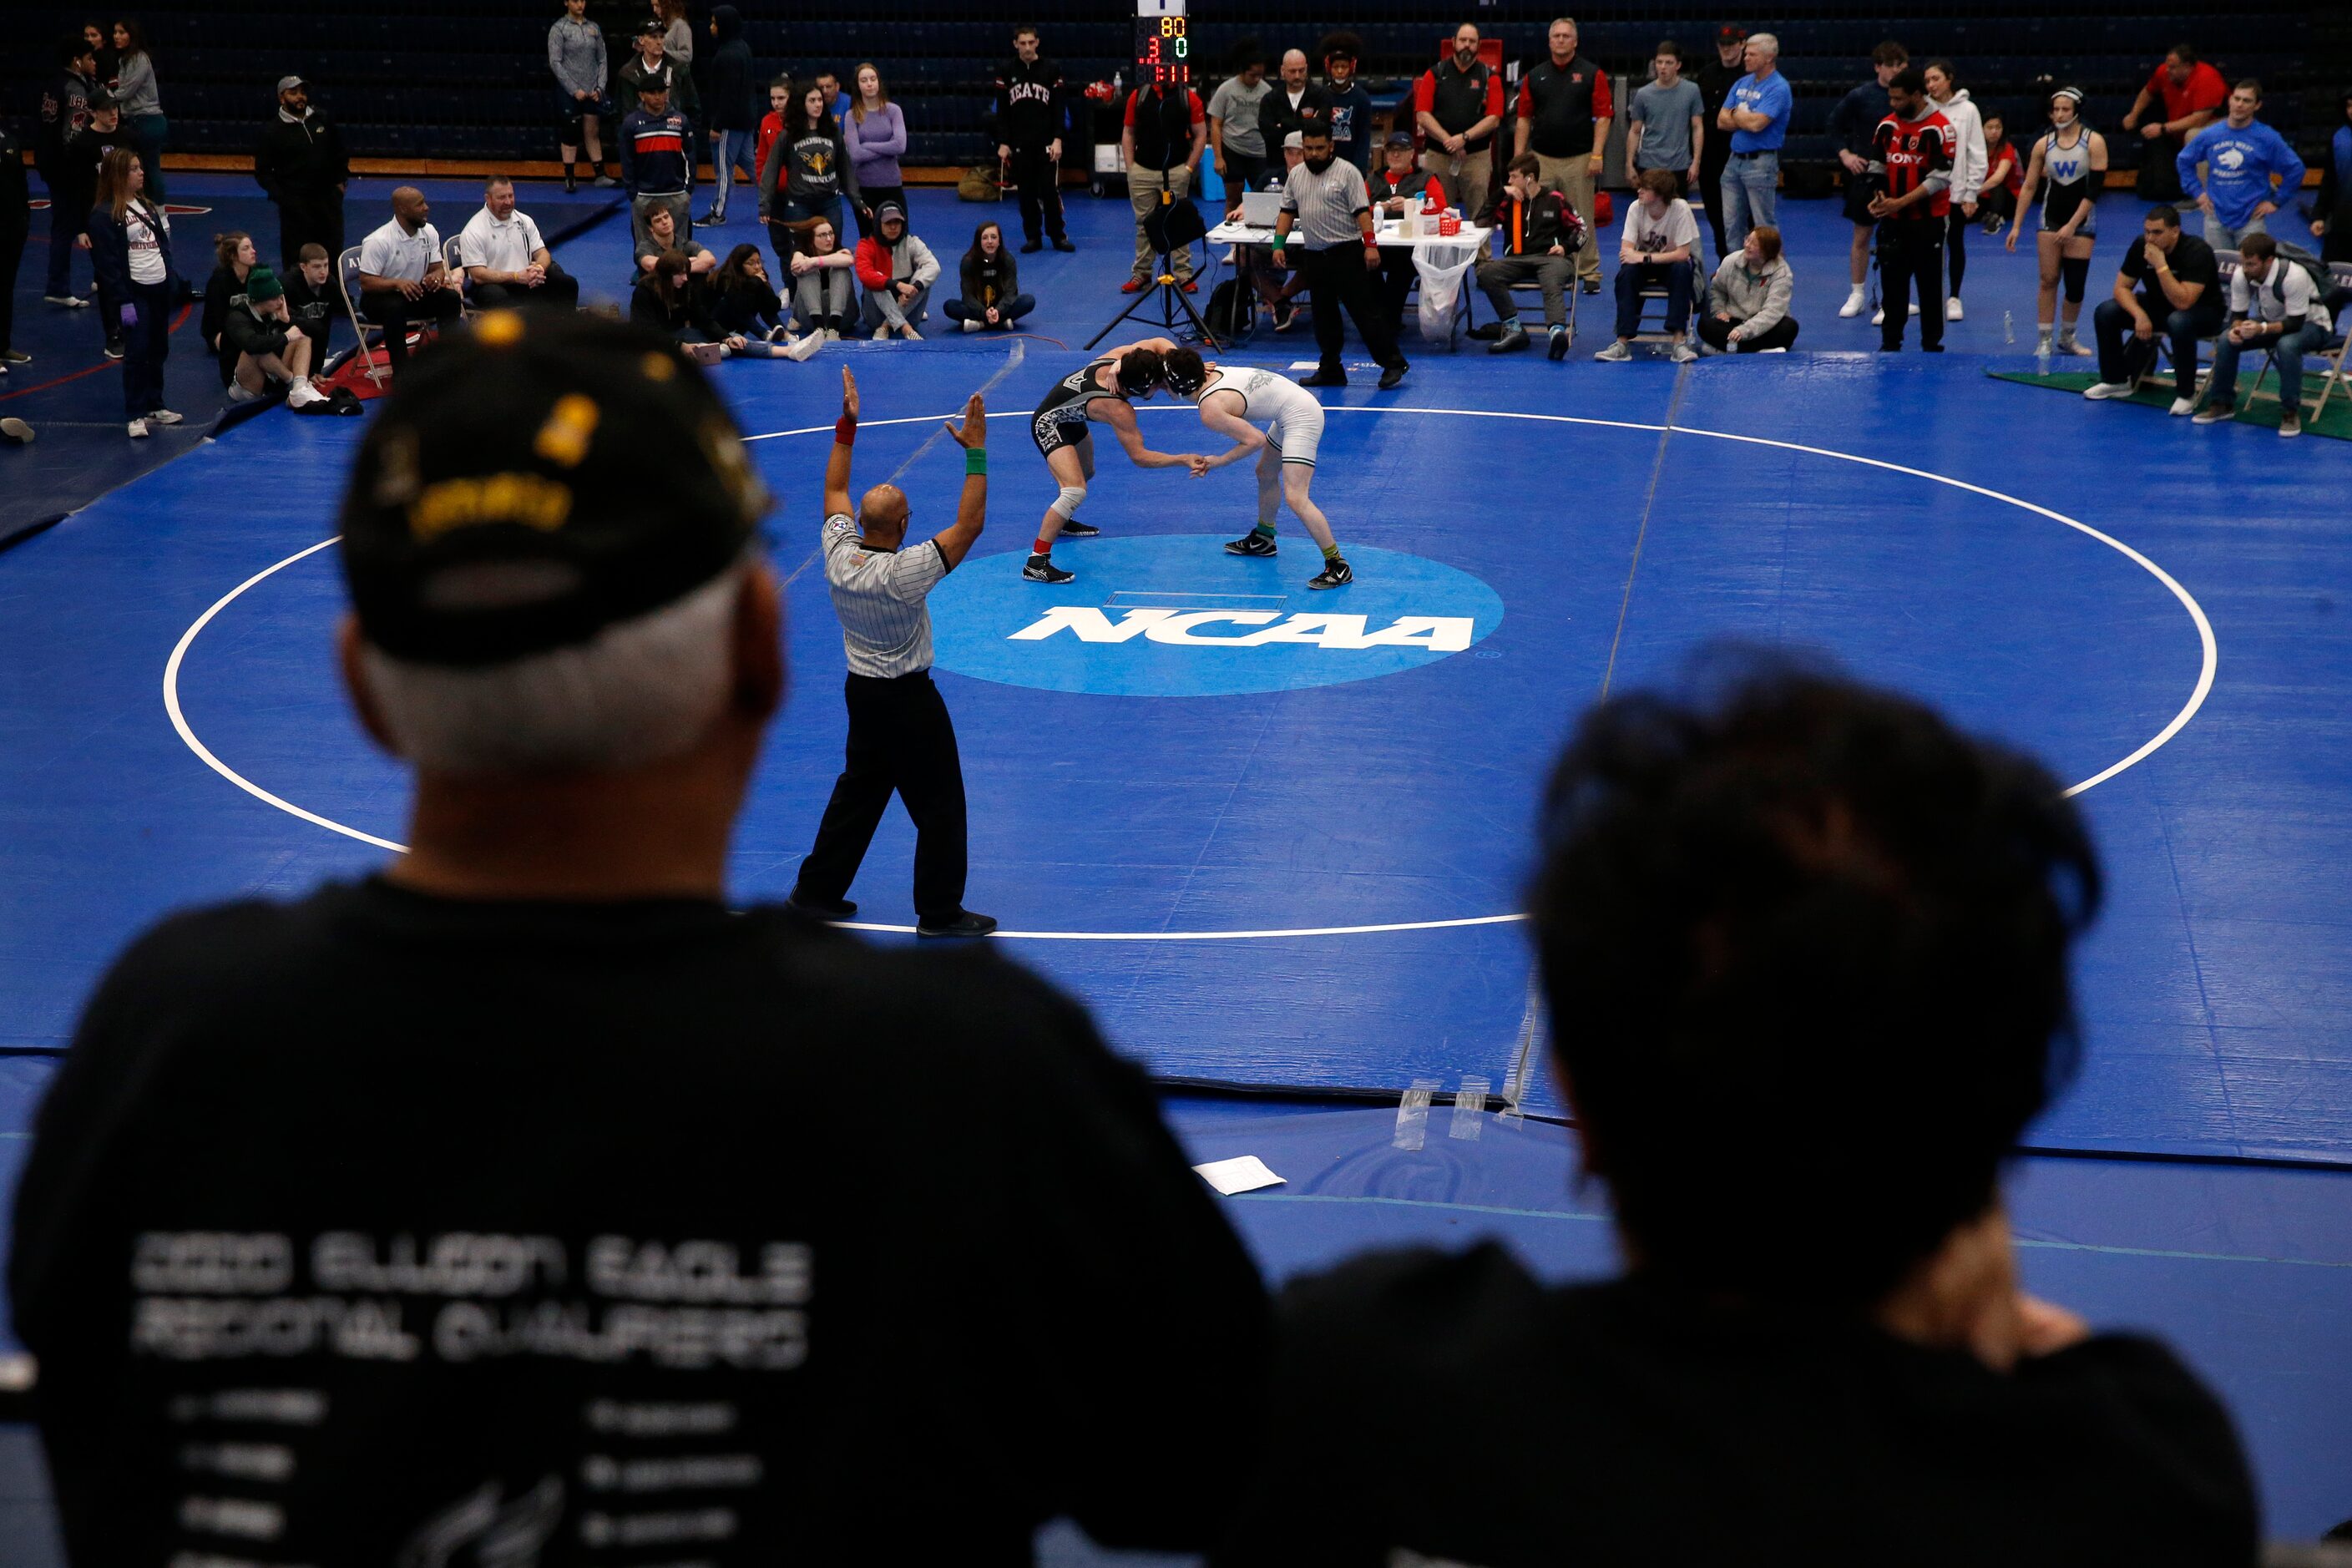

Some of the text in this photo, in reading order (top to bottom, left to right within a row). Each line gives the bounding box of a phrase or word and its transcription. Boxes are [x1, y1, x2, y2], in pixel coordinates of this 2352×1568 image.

[1161, 17, 1186, 38] 80
[1149, 37, 1187, 58] 3 0
[2053, 161, 2078, 178] W
[1006, 606, 1474, 652] NCAA
[586, 1233, 815, 1305] EAGLE
